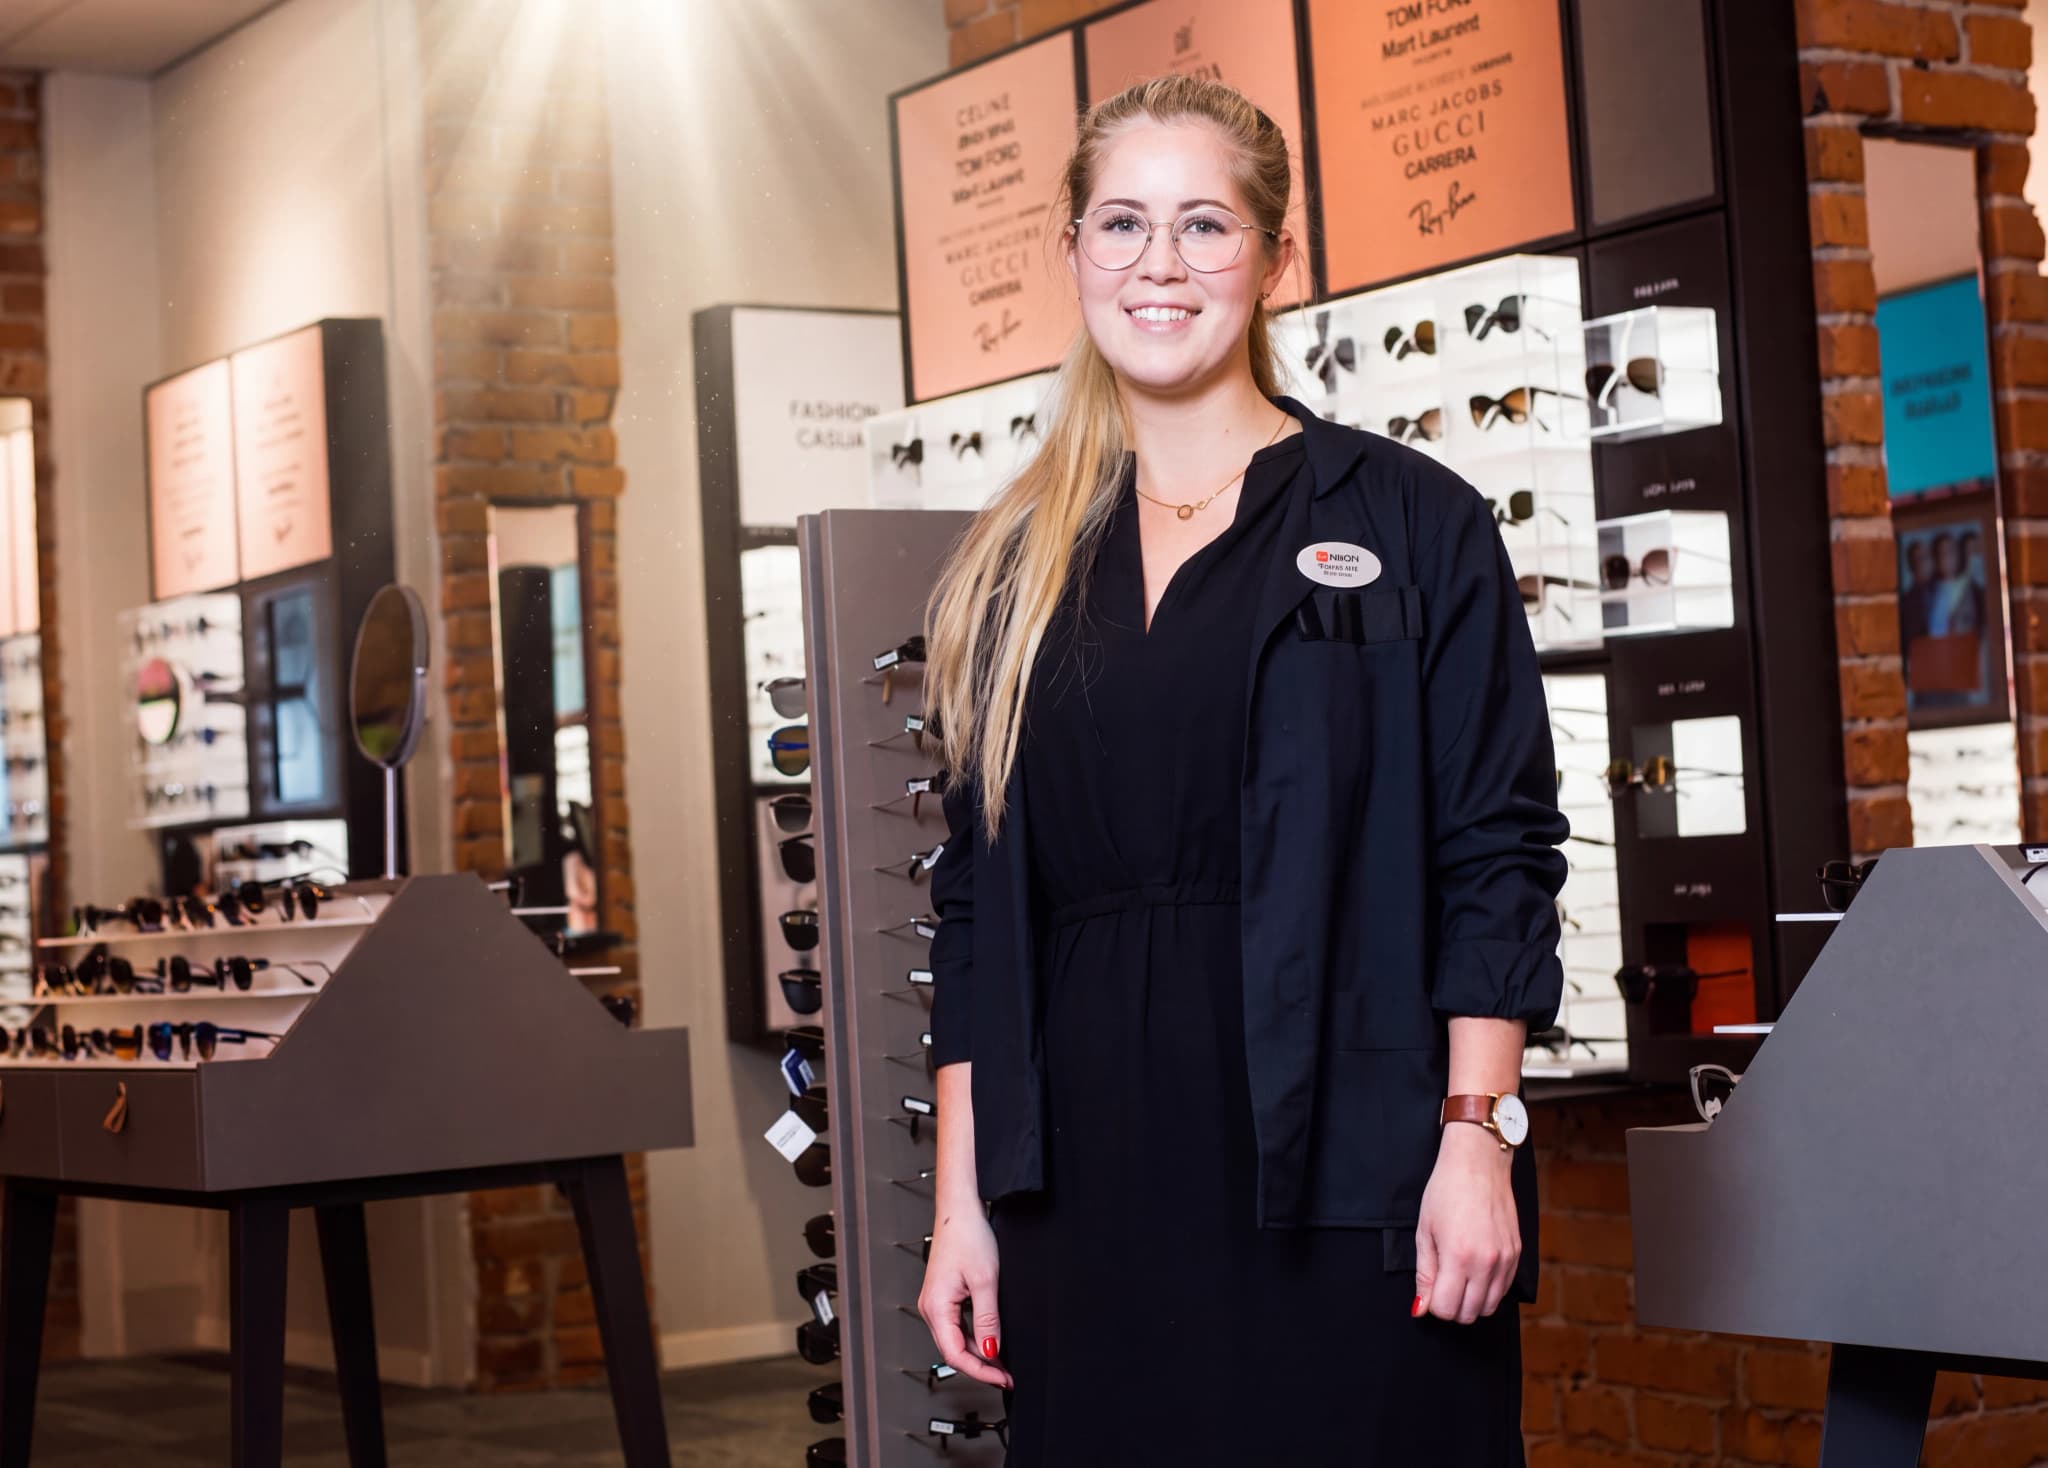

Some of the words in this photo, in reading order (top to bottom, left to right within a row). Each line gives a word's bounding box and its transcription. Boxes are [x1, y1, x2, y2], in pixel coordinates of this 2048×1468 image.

[1386, 0, 1423, 30] TOM
[1427, 0, 1472, 16] FO
[1371, 104, 1421, 131] MARC
[1430, 78, 1503, 117] JACOBS
[1392, 109, 1485, 157] GUCCI
[1404, 145, 1478, 180] CARRERA
[960, 248, 1029, 289] GUCCI
[796, 428, 866, 449] CASUA
